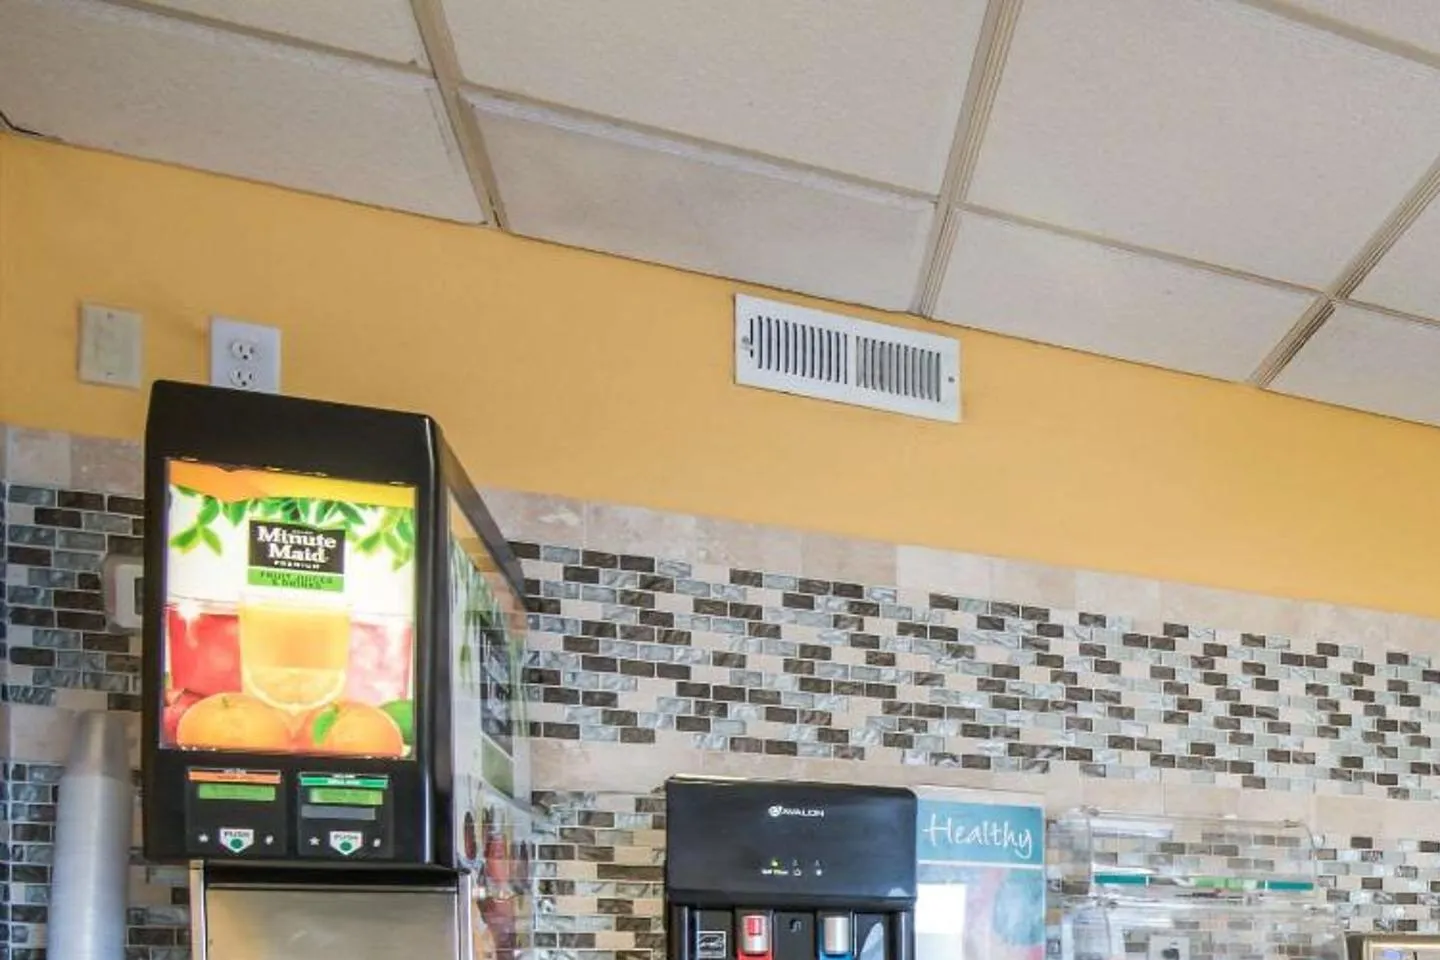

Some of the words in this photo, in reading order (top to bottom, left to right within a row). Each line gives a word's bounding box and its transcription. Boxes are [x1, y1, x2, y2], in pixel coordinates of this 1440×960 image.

[256, 525, 337, 549] Minute
[268, 542, 328, 563] Maid
[223, 830, 250, 839] PUSH
[921, 812, 1033, 860] Healthy
